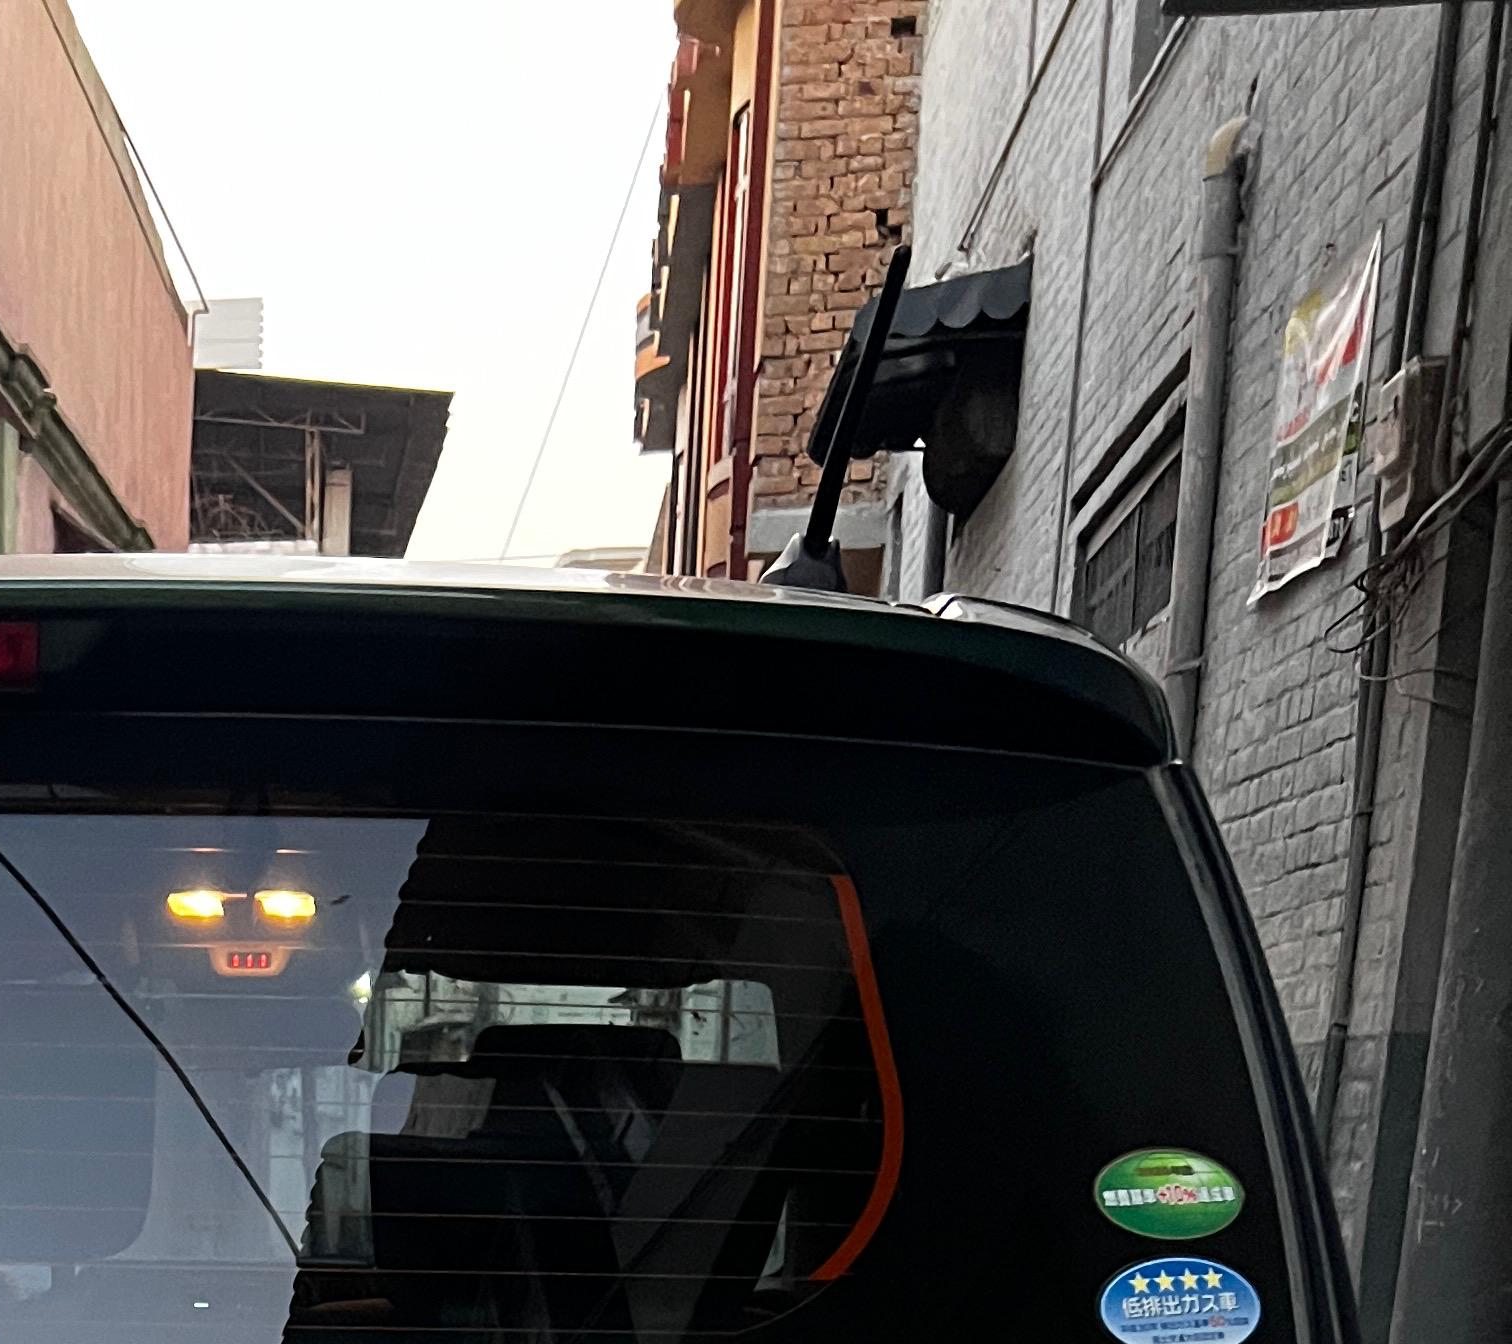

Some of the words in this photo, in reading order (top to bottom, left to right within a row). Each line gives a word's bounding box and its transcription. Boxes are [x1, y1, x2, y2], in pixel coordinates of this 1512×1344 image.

[1122, 1292, 1239, 1318] 低排出ガス車
